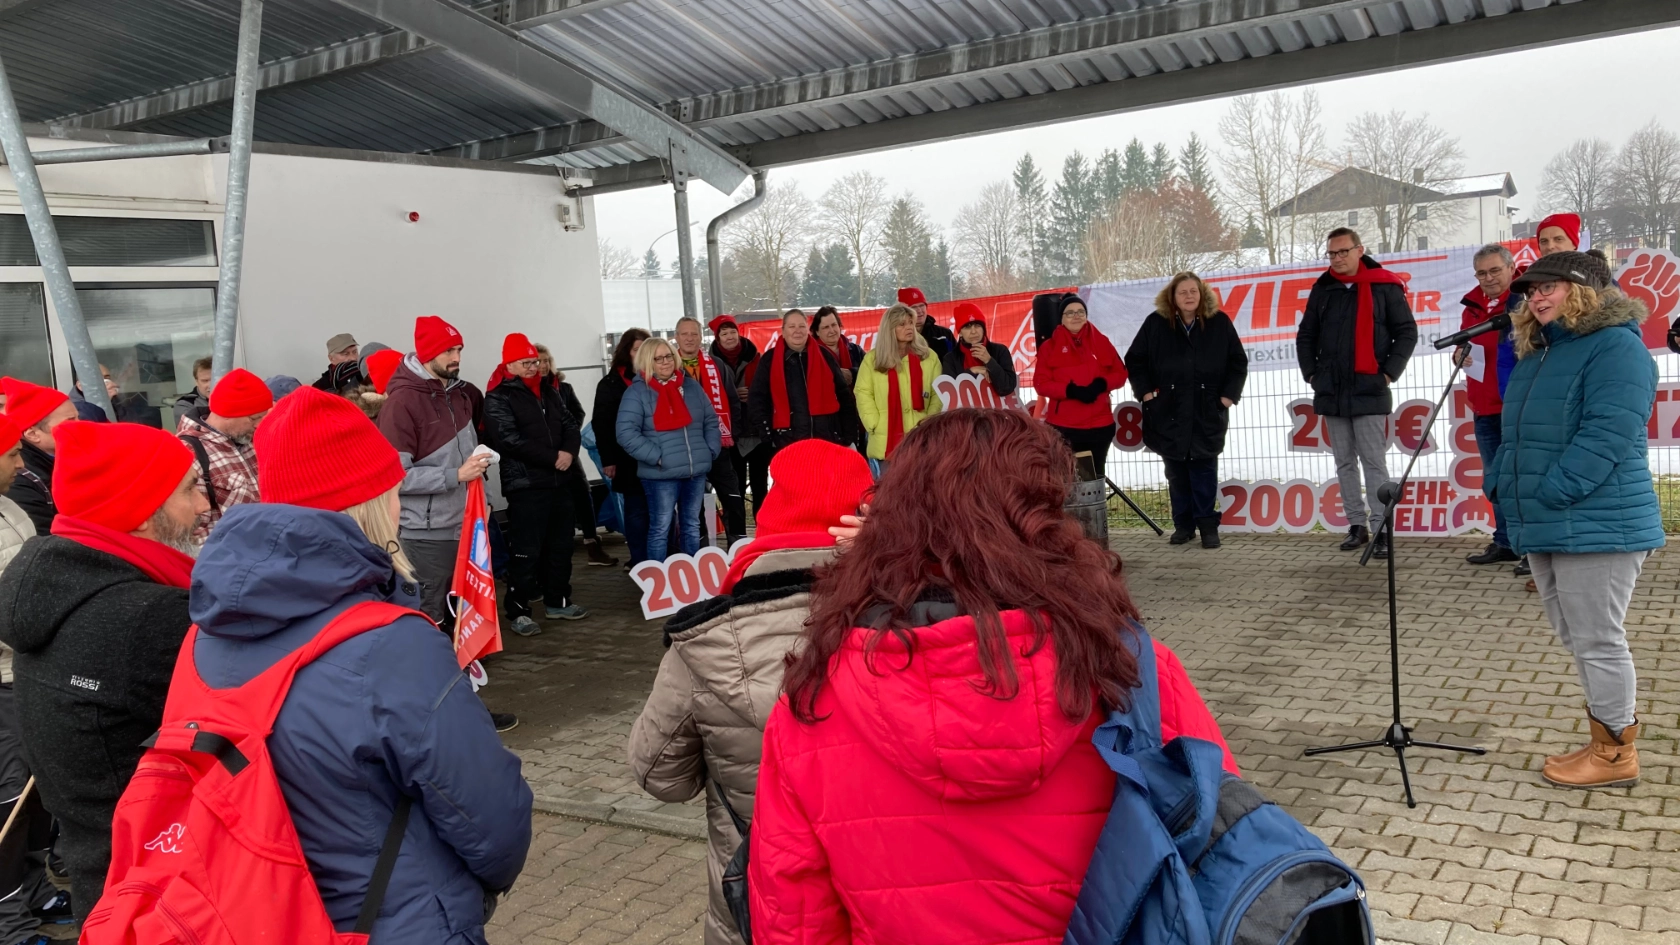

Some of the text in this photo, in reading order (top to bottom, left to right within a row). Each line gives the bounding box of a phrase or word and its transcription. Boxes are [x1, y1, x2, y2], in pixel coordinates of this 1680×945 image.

[705, 364, 722, 410] JETZT!
[1402, 481, 1457, 505] EHR
[1394, 507, 1448, 532] ELD
[637, 545, 747, 612] 200
